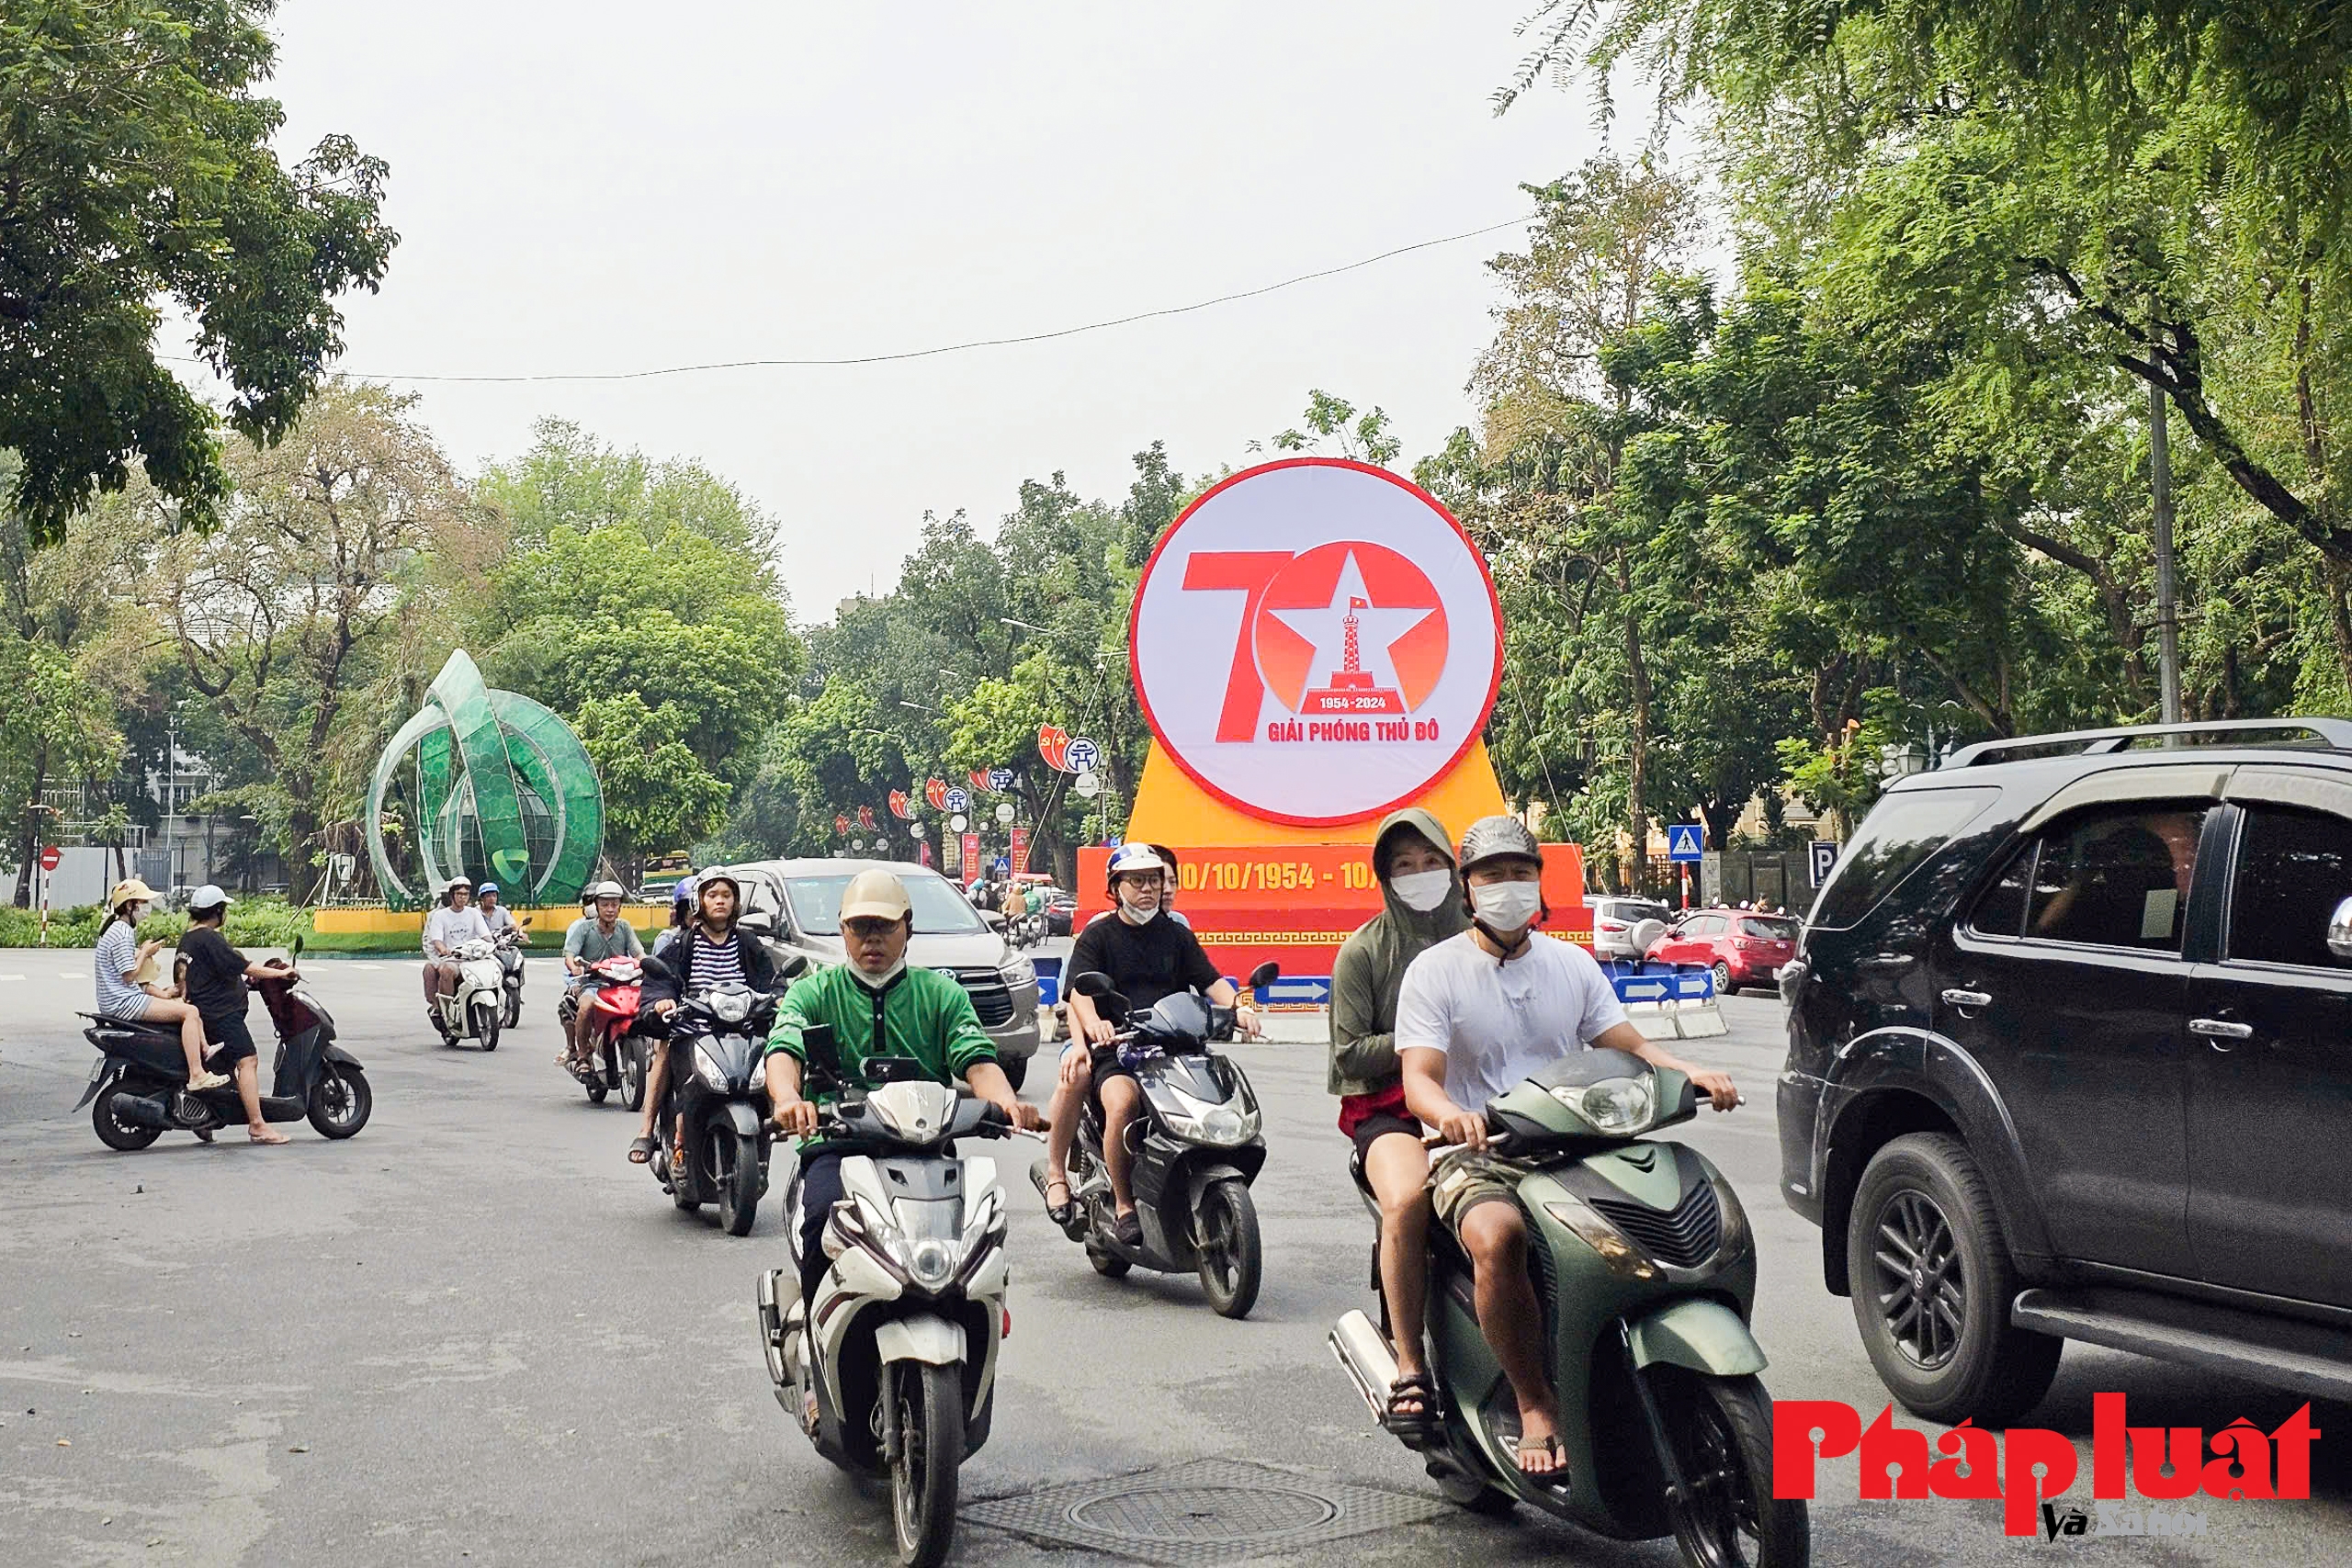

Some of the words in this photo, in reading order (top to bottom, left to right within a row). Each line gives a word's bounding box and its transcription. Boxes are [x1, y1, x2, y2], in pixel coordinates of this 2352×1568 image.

[1319, 696, 1386, 709] 1954-2024
[1268, 717, 1303, 741] GIẢI
[1309, 719, 1370, 741] PHÓNG
[1375, 717, 1409, 741] THỦ
[1415, 718, 1440, 741] ĐÔ
[1817, 849, 1833, 877] P
